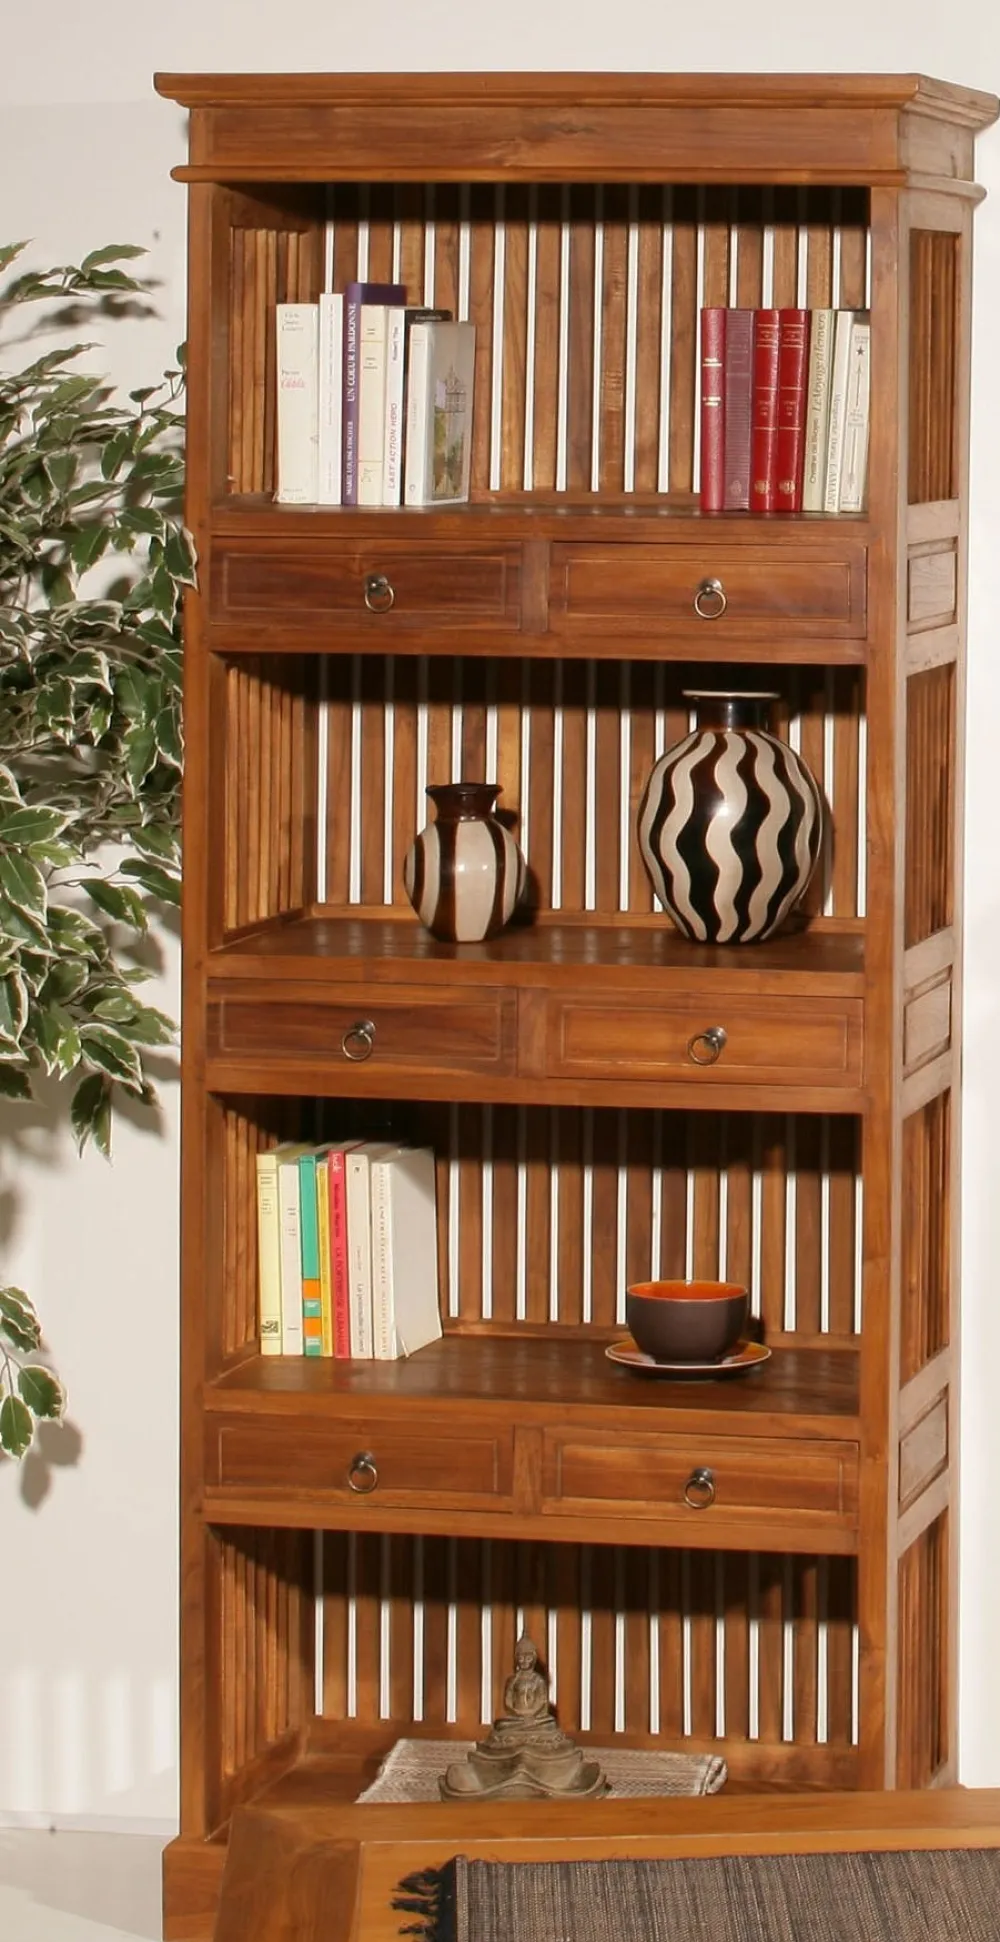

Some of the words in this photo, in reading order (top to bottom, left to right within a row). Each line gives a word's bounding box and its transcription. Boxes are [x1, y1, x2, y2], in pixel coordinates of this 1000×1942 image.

[347, 303, 357, 353] PARDONNE
[347, 354, 356, 386] COEUR
[347, 387, 355, 402] UN
[390, 403, 398, 427] HERO
[389, 429, 397, 462] ACTION
[387, 465, 396, 489] LAST
